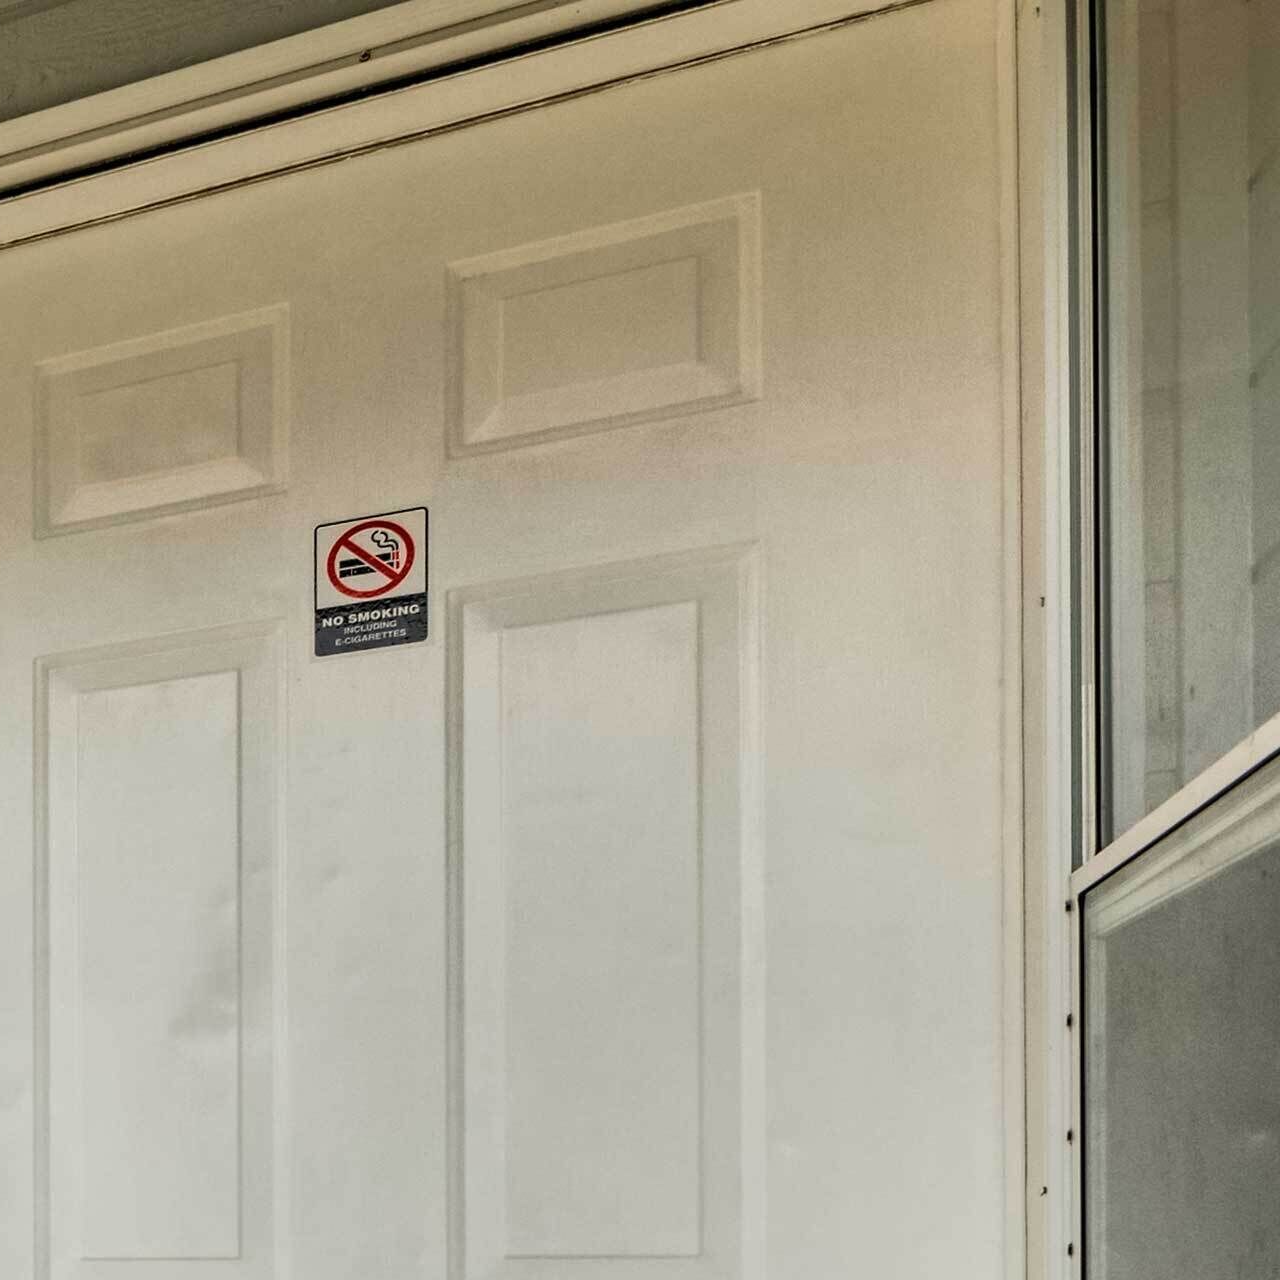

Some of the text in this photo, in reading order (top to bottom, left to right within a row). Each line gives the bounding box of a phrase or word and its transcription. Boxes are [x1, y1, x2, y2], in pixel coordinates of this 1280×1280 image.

[322, 604, 420, 628] NO SMOKING
[344, 620, 397, 635] INCLUDING
[335, 628, 407, 646] E-CIGARETTES
